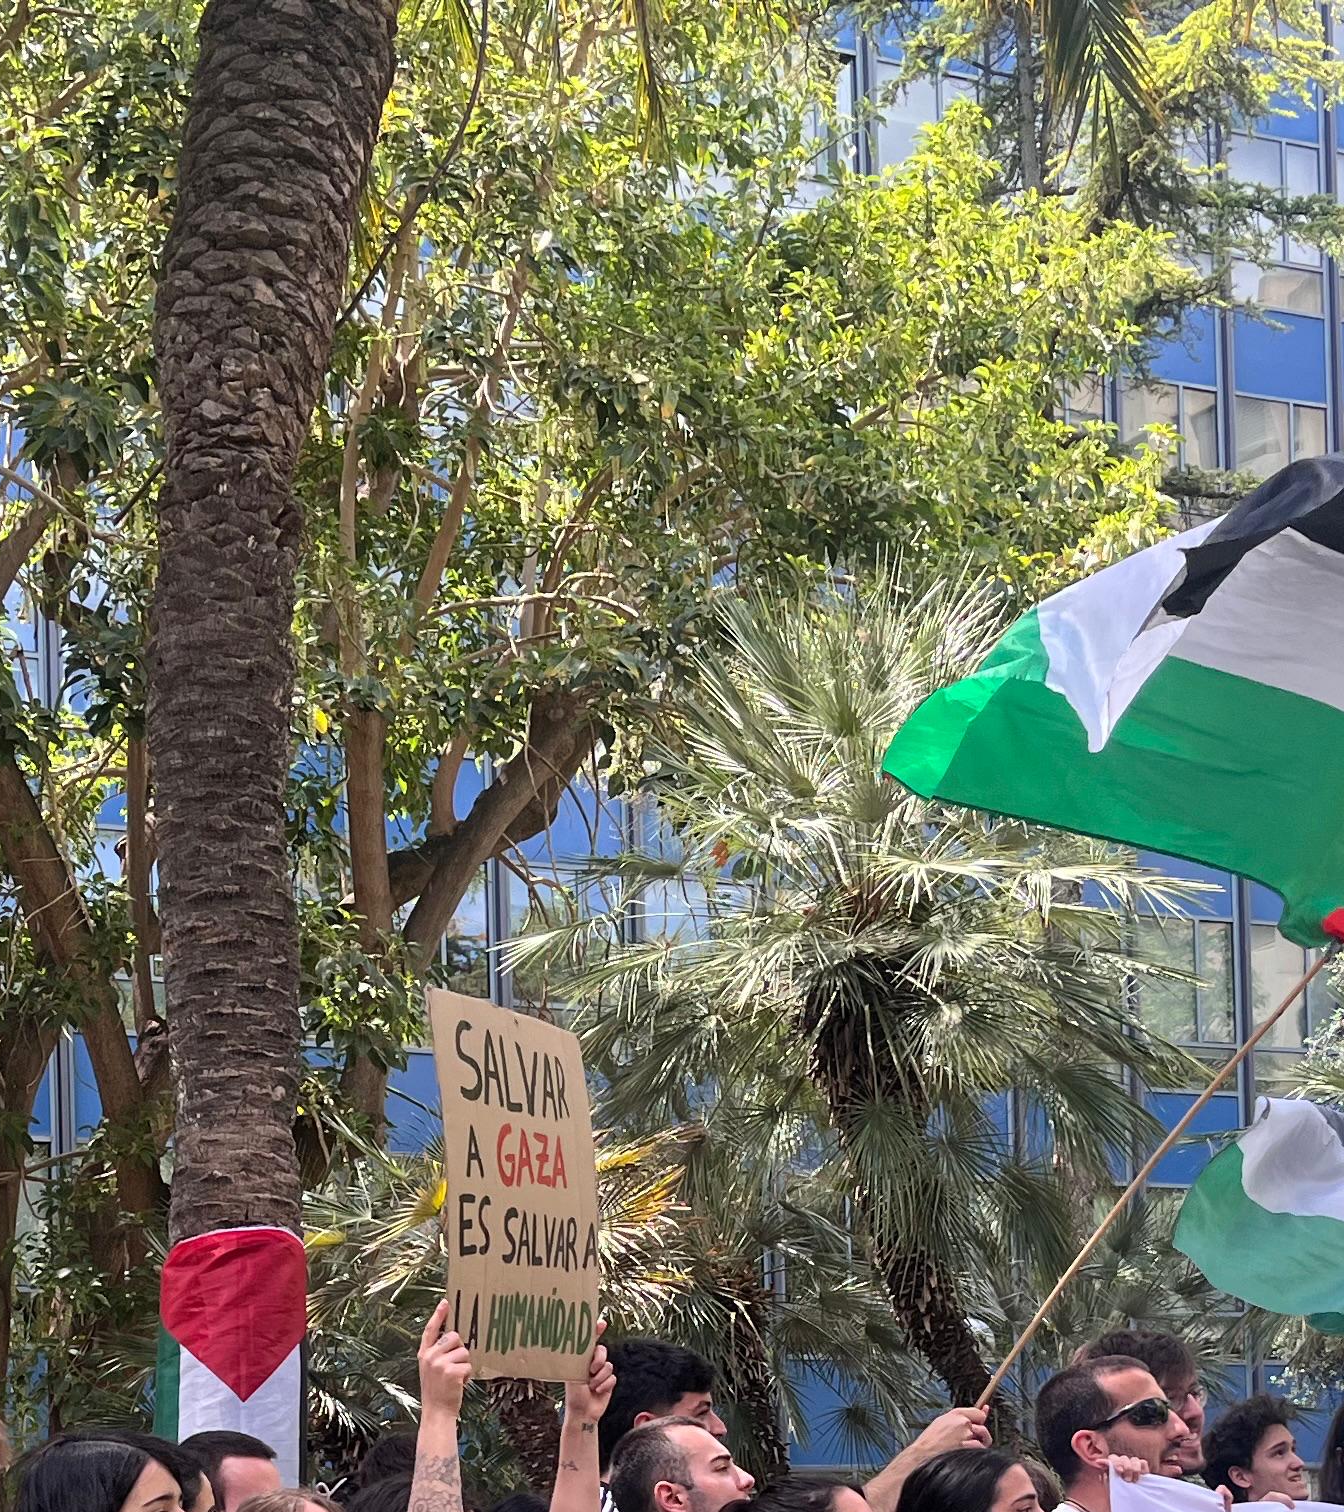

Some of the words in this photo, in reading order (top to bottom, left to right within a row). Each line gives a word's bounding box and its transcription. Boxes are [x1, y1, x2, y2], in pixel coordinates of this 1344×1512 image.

[455, 1020, 570, 1121] SALVAR
[466, 1125, 484, 1178] A
[496, 1123, 568, 1189] GAZA
[458, 1194, 491, 1257] ES
[502, 1207, 579, 1271] SALVAR
[582, 1222, 598, 1269] A
